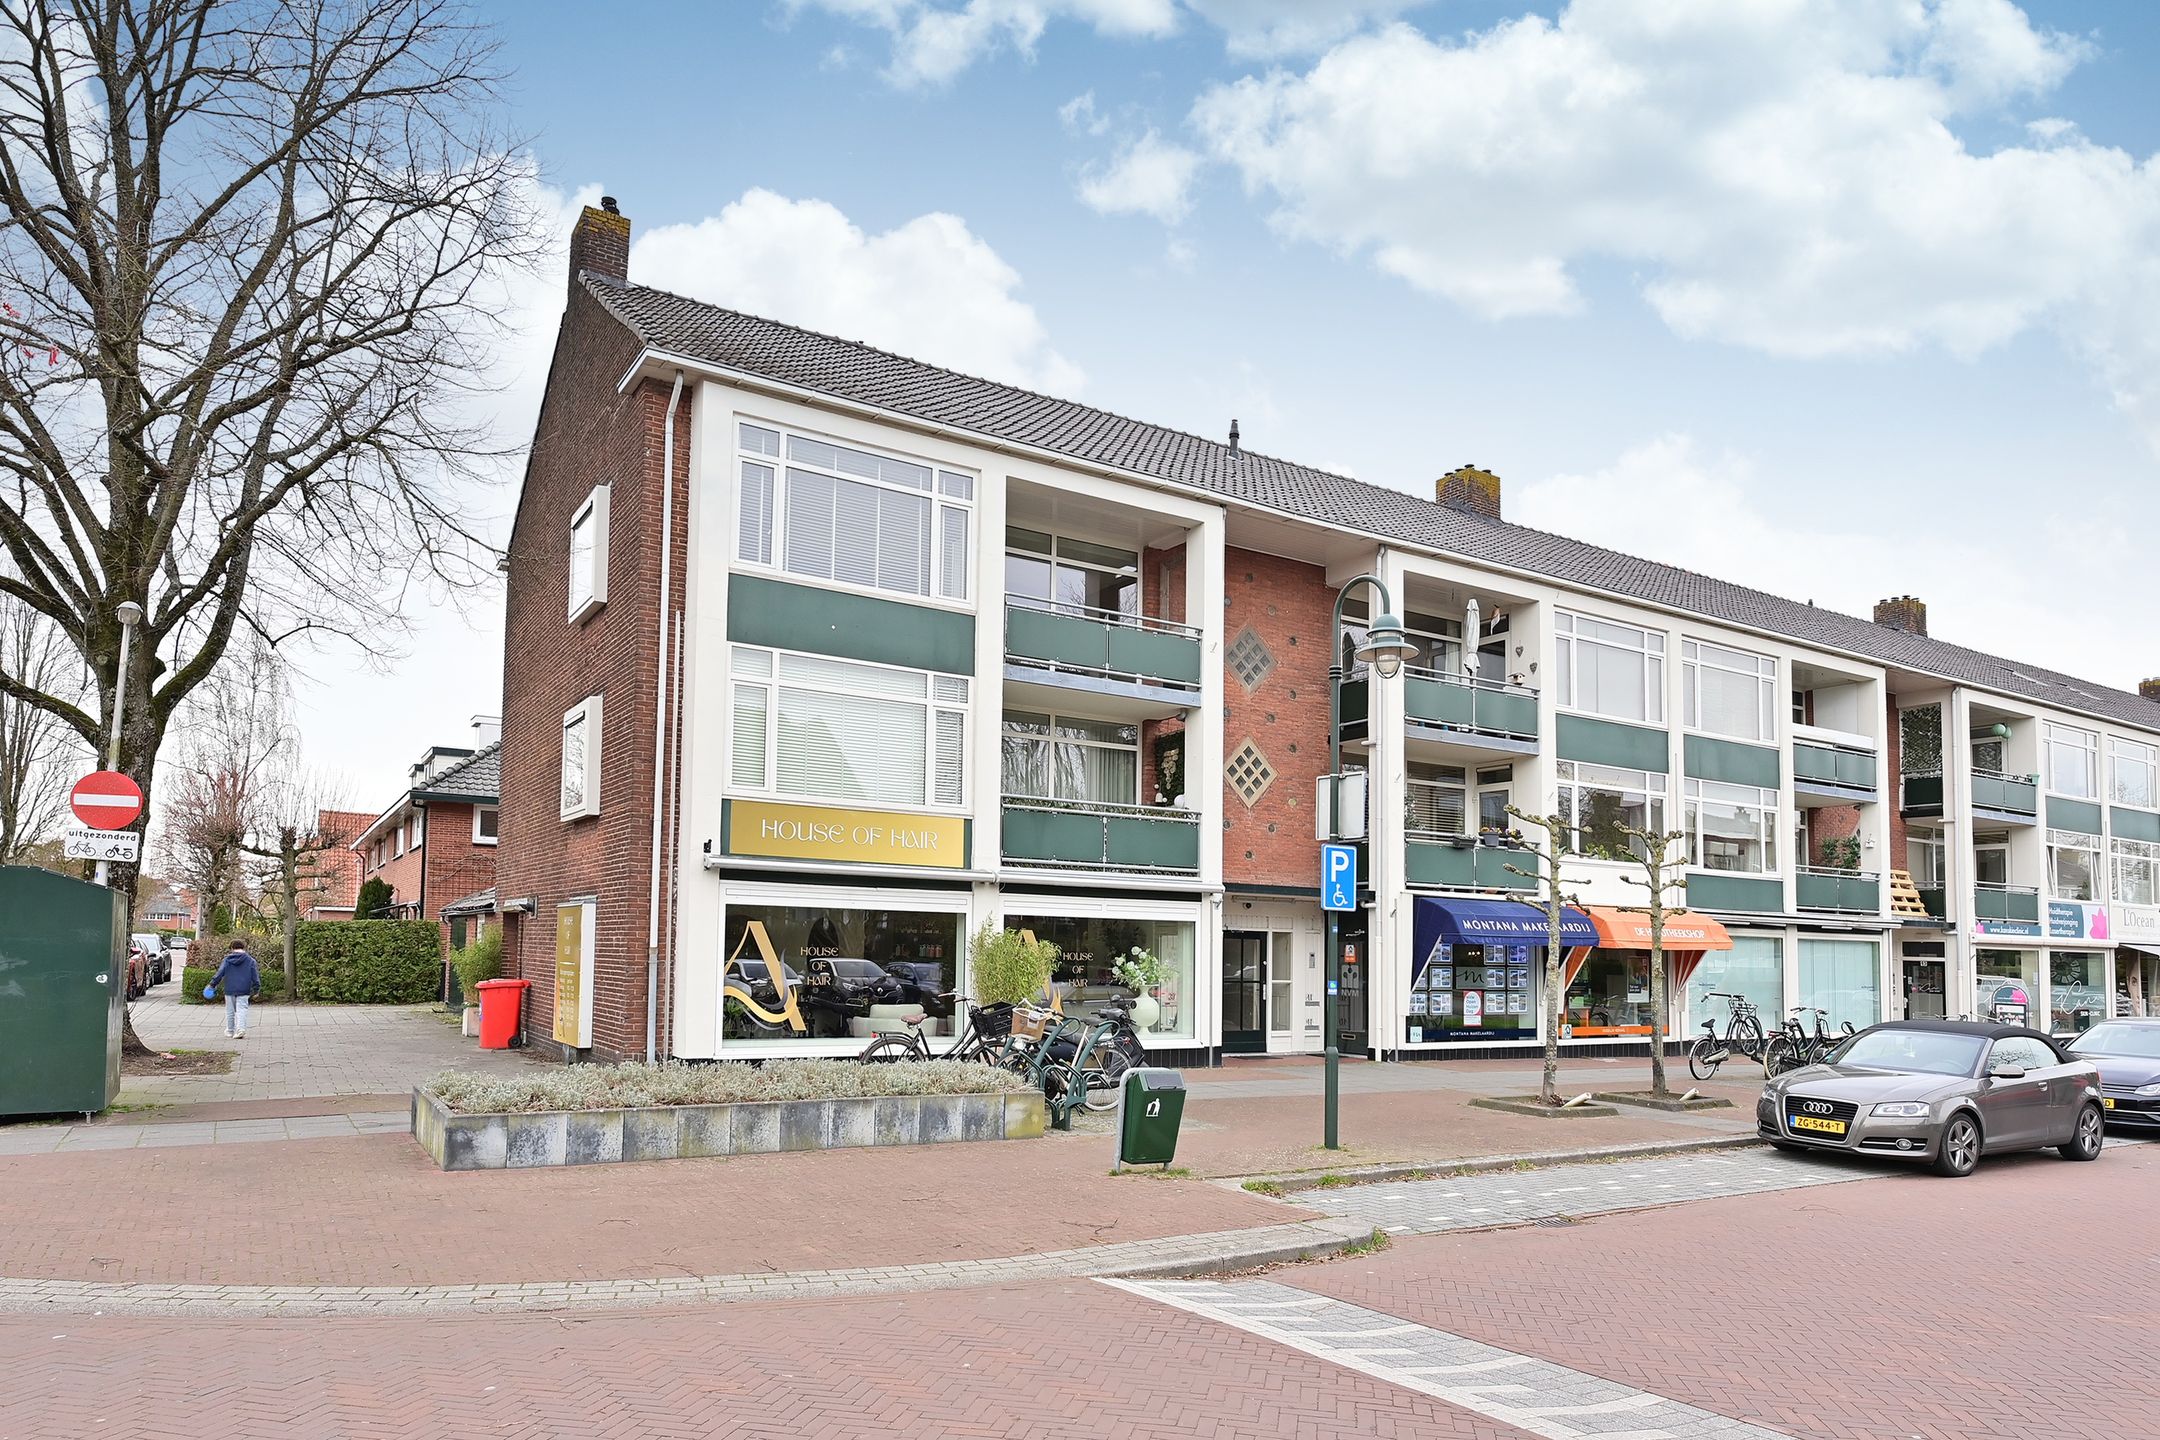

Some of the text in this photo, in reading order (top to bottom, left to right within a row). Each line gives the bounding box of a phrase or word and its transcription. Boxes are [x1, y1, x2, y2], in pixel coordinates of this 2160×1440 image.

[68, 830, 136, 842] uitgezonderd
[761, 818, 938, 850] HOUSE OF HAIR
[1331, 850, 1349, 882] P
[1462, 919, 1591, 933] MONTANA MAKEARDIJ
[1634, 927, 1705, 938] DE HOTHEEKSHOP
[800, 946, 839, 957] HOUSE
[1062, 952, 1094, 962] HOUSE
[811, 961, 827, 971] OF
[1071, 966, 1085, 975] OF
[807, 976, 832, 986] HAIR
[1068, 978, 1089, 987] HAIR
[1341, 988, 1360, 998] NVM
[1797, 1118, 1841, 1131] ZG-544-T
